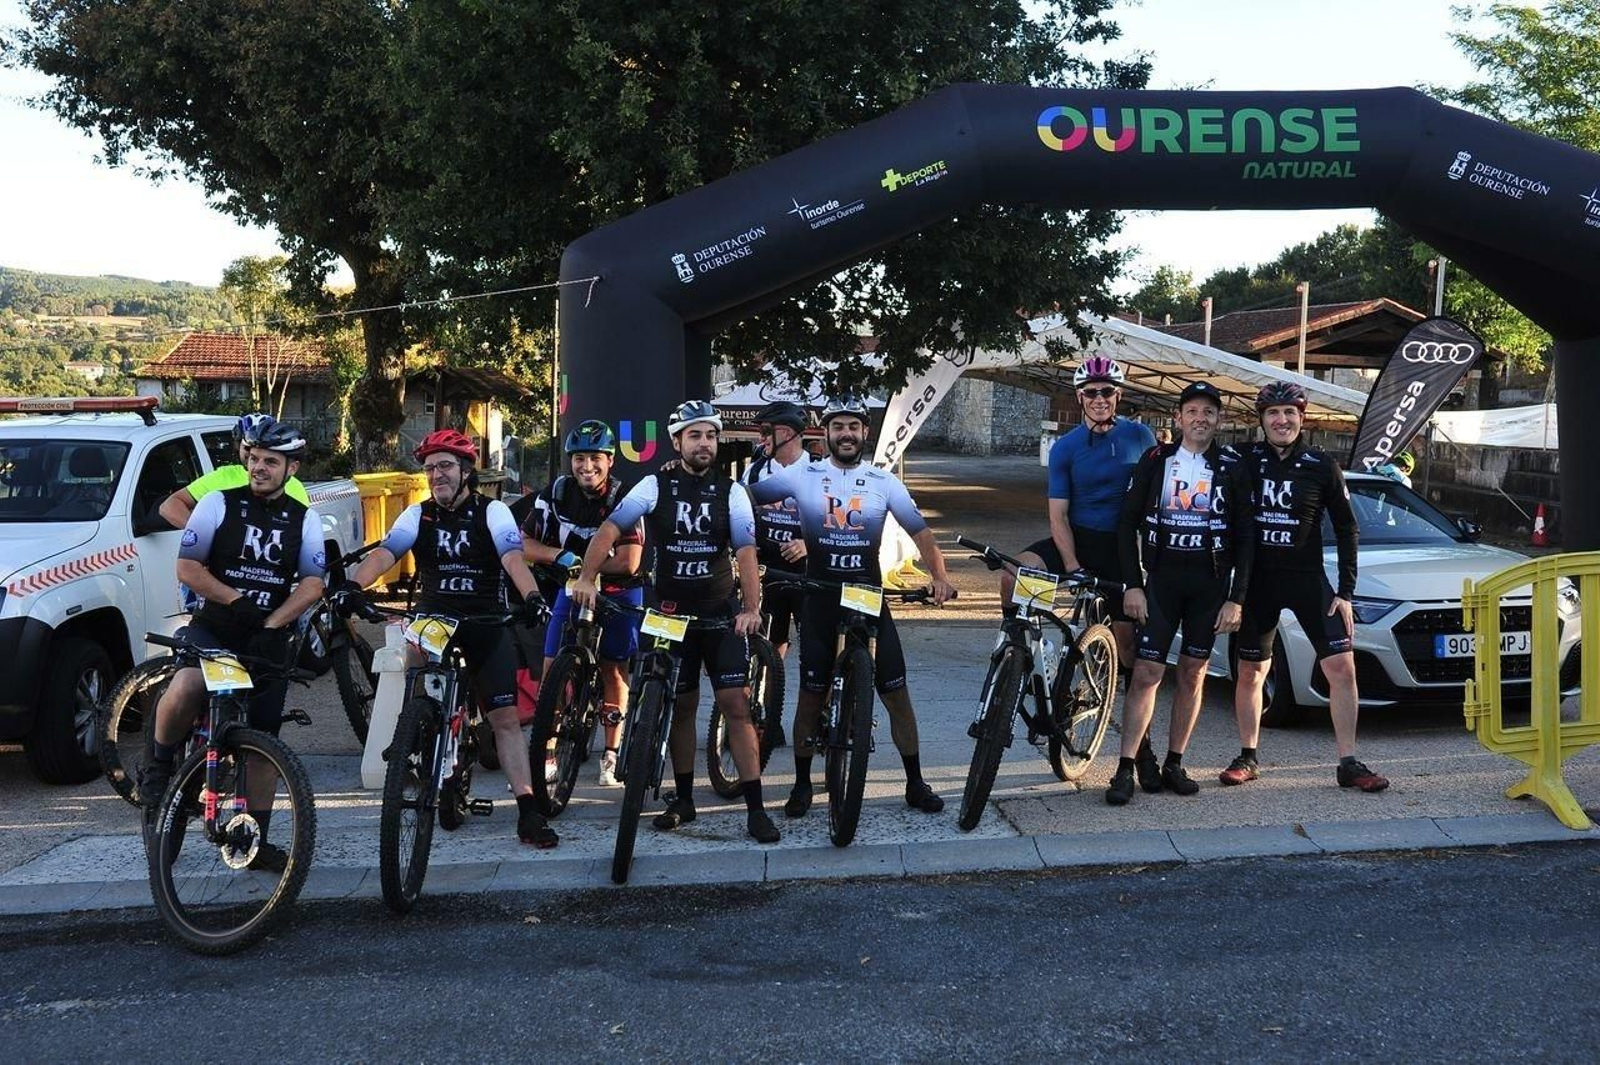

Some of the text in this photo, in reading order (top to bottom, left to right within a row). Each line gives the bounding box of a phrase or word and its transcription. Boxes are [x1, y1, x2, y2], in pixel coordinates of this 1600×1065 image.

[1037, 105, 1361, 152] OURENSE
[900, 160, 946, 186] DEPORTE
[1242, 161, 1357, 180] NATURAL
[1474, 162, 1550, 196] DEPUTACIÓN
[1469, 173, 1525, 200] OURENSE
[805, 200, 840, 220] inorde
[810, 203, 866, 230] turismo Ourense
[693, 226, 767, 262] DEPUTACIÓN
[699, 245, 753, 273] OURENSE
[1362, 381, 1426, 472] Apersa
[620, 421, 656, 463] U
[768, 527, 793, 541] TCR
[1169, 533, 1202, 547] TCR
[1262, 530, 1291, 544] TCR
[676, 560, 709, 576] TCR
[829, 553, 862, 569] TCR
